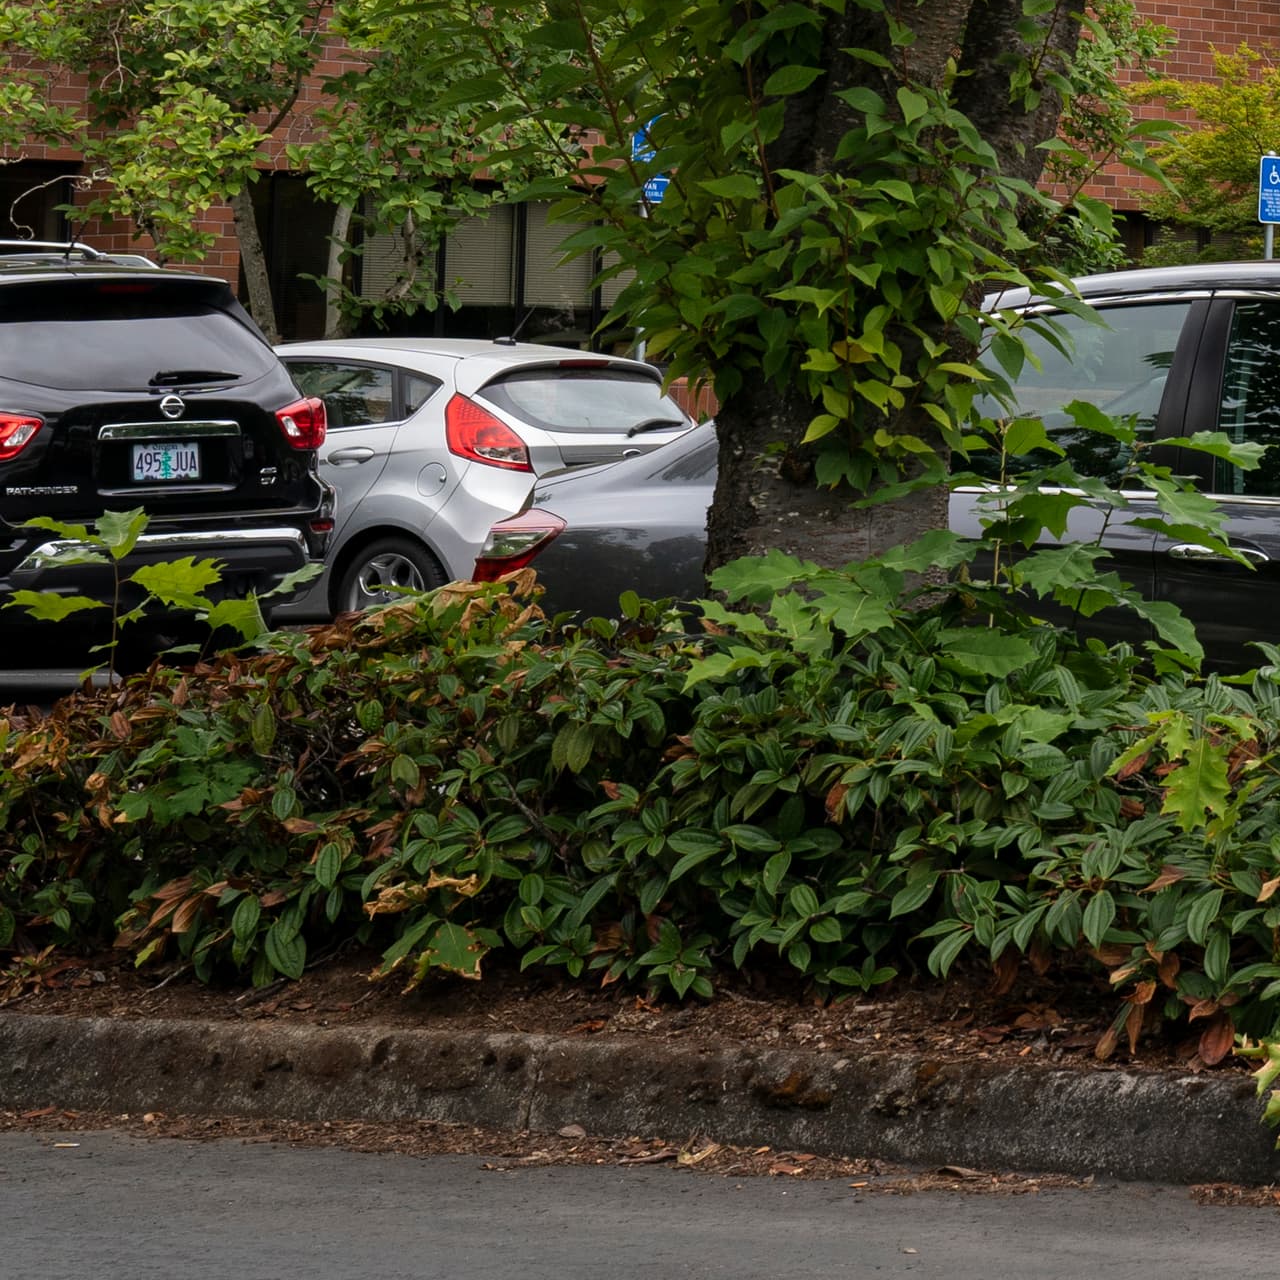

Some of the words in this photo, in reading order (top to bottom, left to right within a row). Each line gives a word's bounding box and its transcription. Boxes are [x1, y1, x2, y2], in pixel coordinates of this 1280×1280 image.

[135, 451, 162, 473] 495
[171, 450, 198, 472] JUA
[6, 485, 78, 496] PATHFINDER
